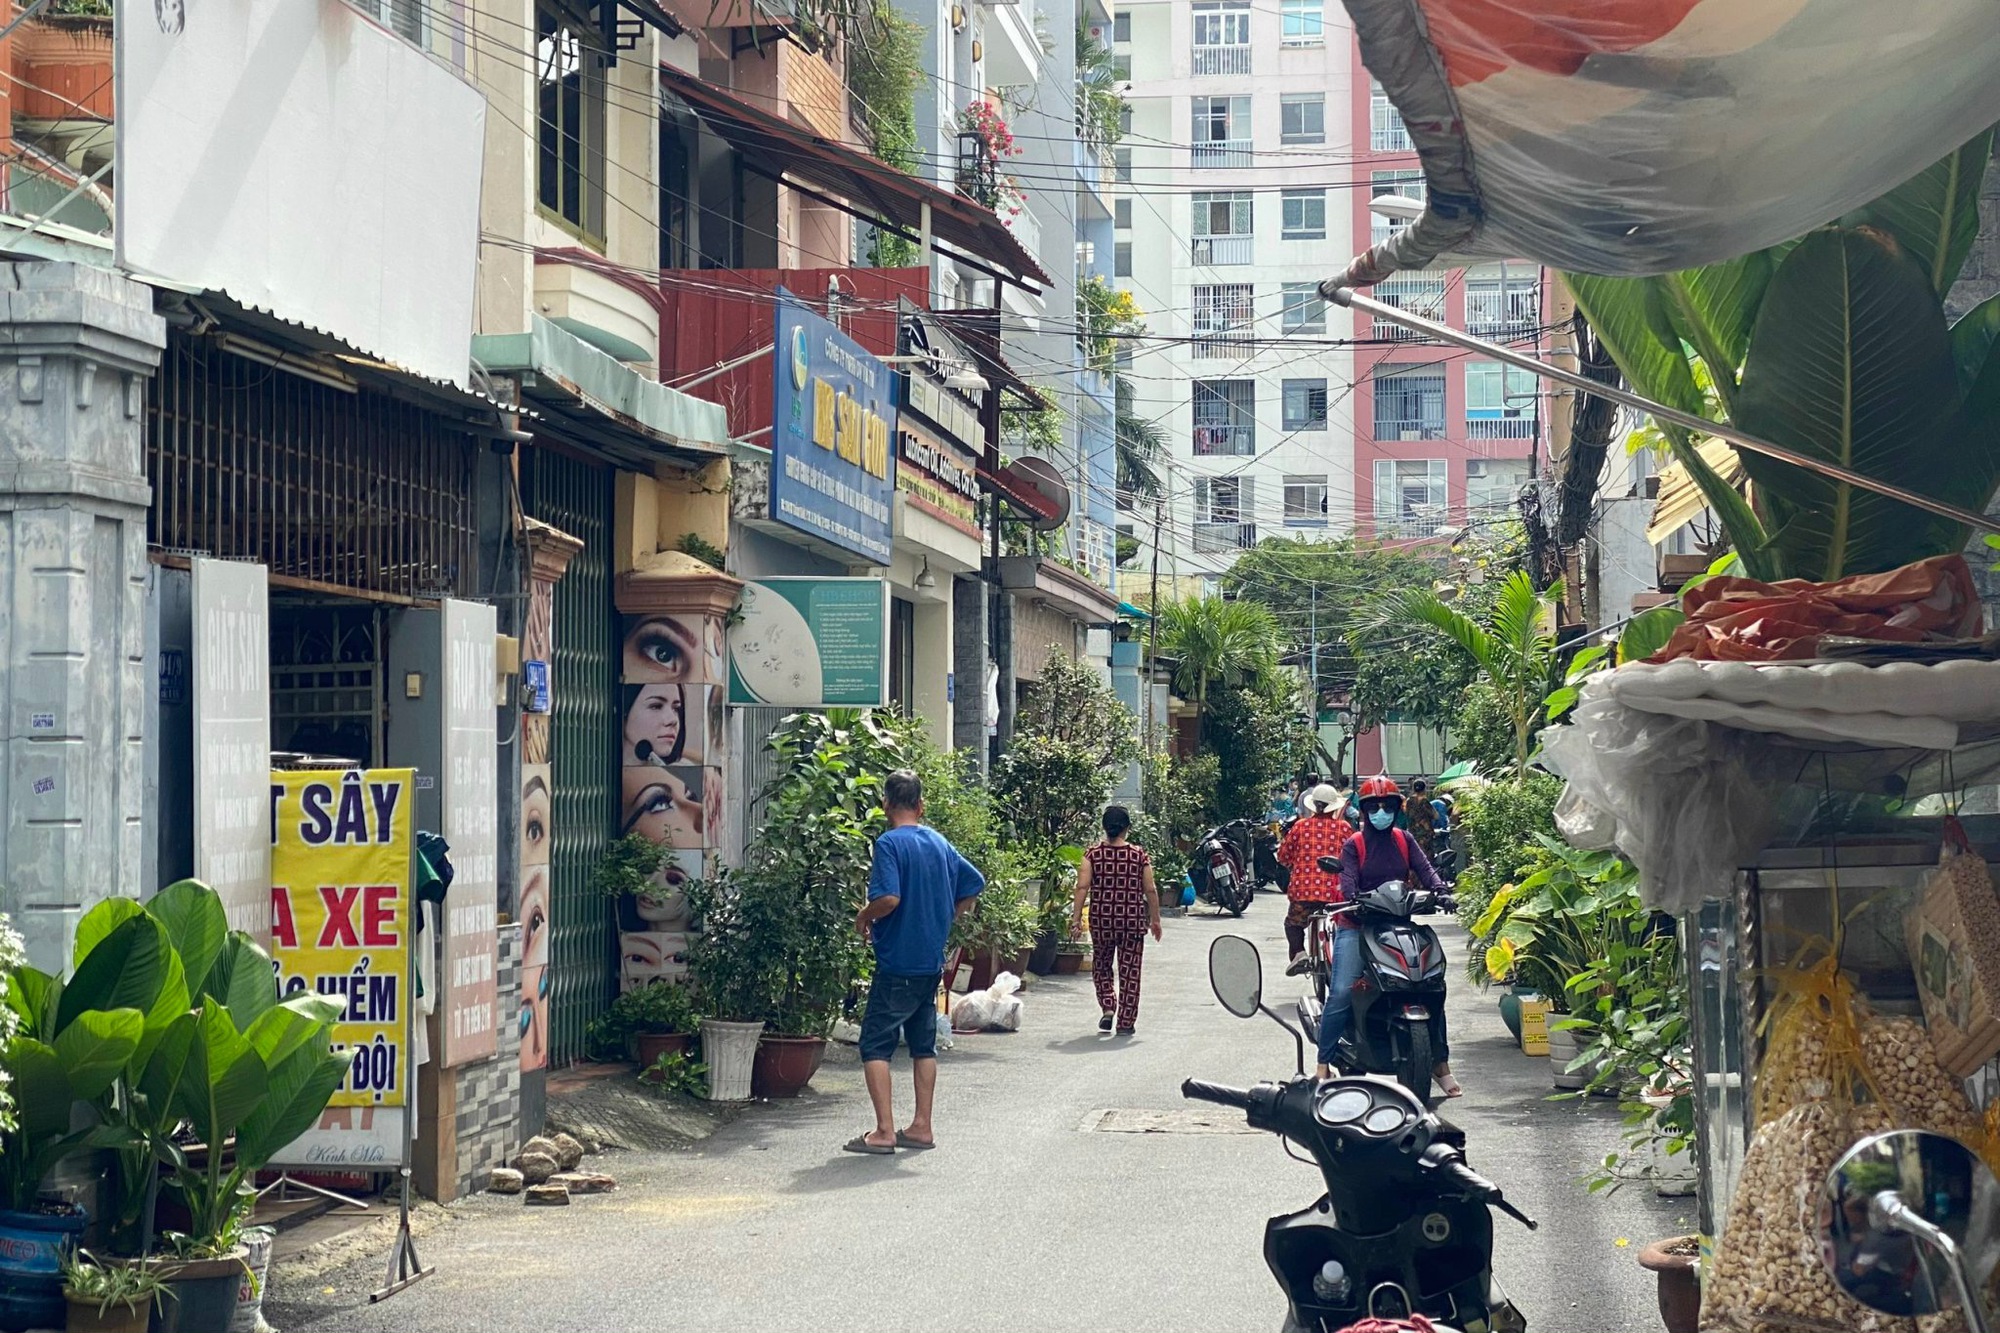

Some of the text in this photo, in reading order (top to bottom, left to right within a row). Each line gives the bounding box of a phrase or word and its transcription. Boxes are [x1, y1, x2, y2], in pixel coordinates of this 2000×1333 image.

[836, 384, 862, 467] SÀI
[863, 399, 888, 481] GÒN
[905, 433, 930, 469] Lubricant
[961, 470, 970, 494] Car
[207, 583, 261, 711] GIẶT SẤY
[453, 618, 475, 711] RỬA
[478, 643, 492, 711] XE
[454, 756, 462, 785] XE
[318, 886, 398, 947] XE
[353, 1034, 396, 1101] ĐỘI
